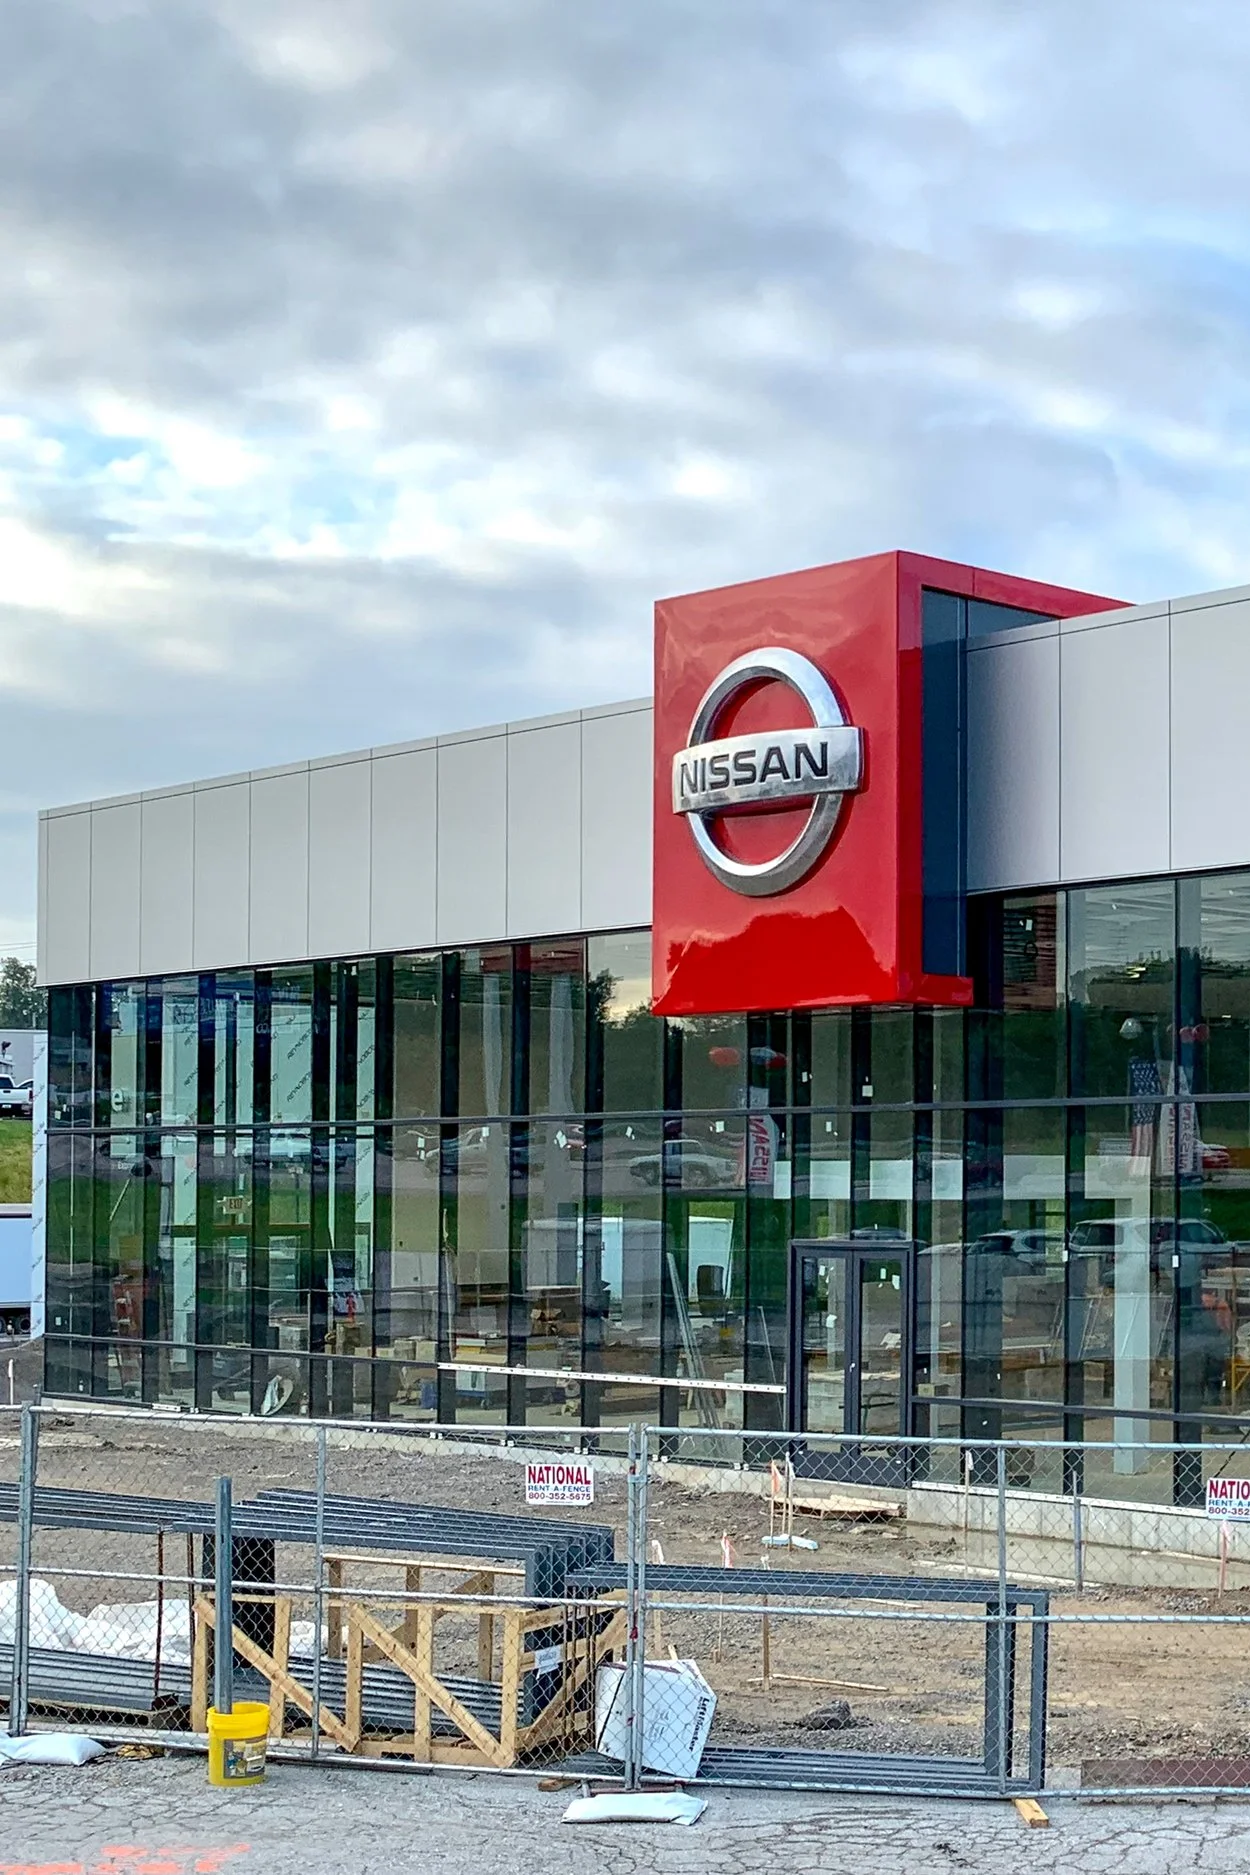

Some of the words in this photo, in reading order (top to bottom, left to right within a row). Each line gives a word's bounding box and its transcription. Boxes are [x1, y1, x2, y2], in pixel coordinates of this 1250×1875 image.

[680, 741, 829, 798] NISSAN
[528, 1465, 592, 1485] NATIONAL
[528, 1485, 591, 1493] RENT-A-FENCE
[528, 1492, 591, 1501] 800-352-5675
